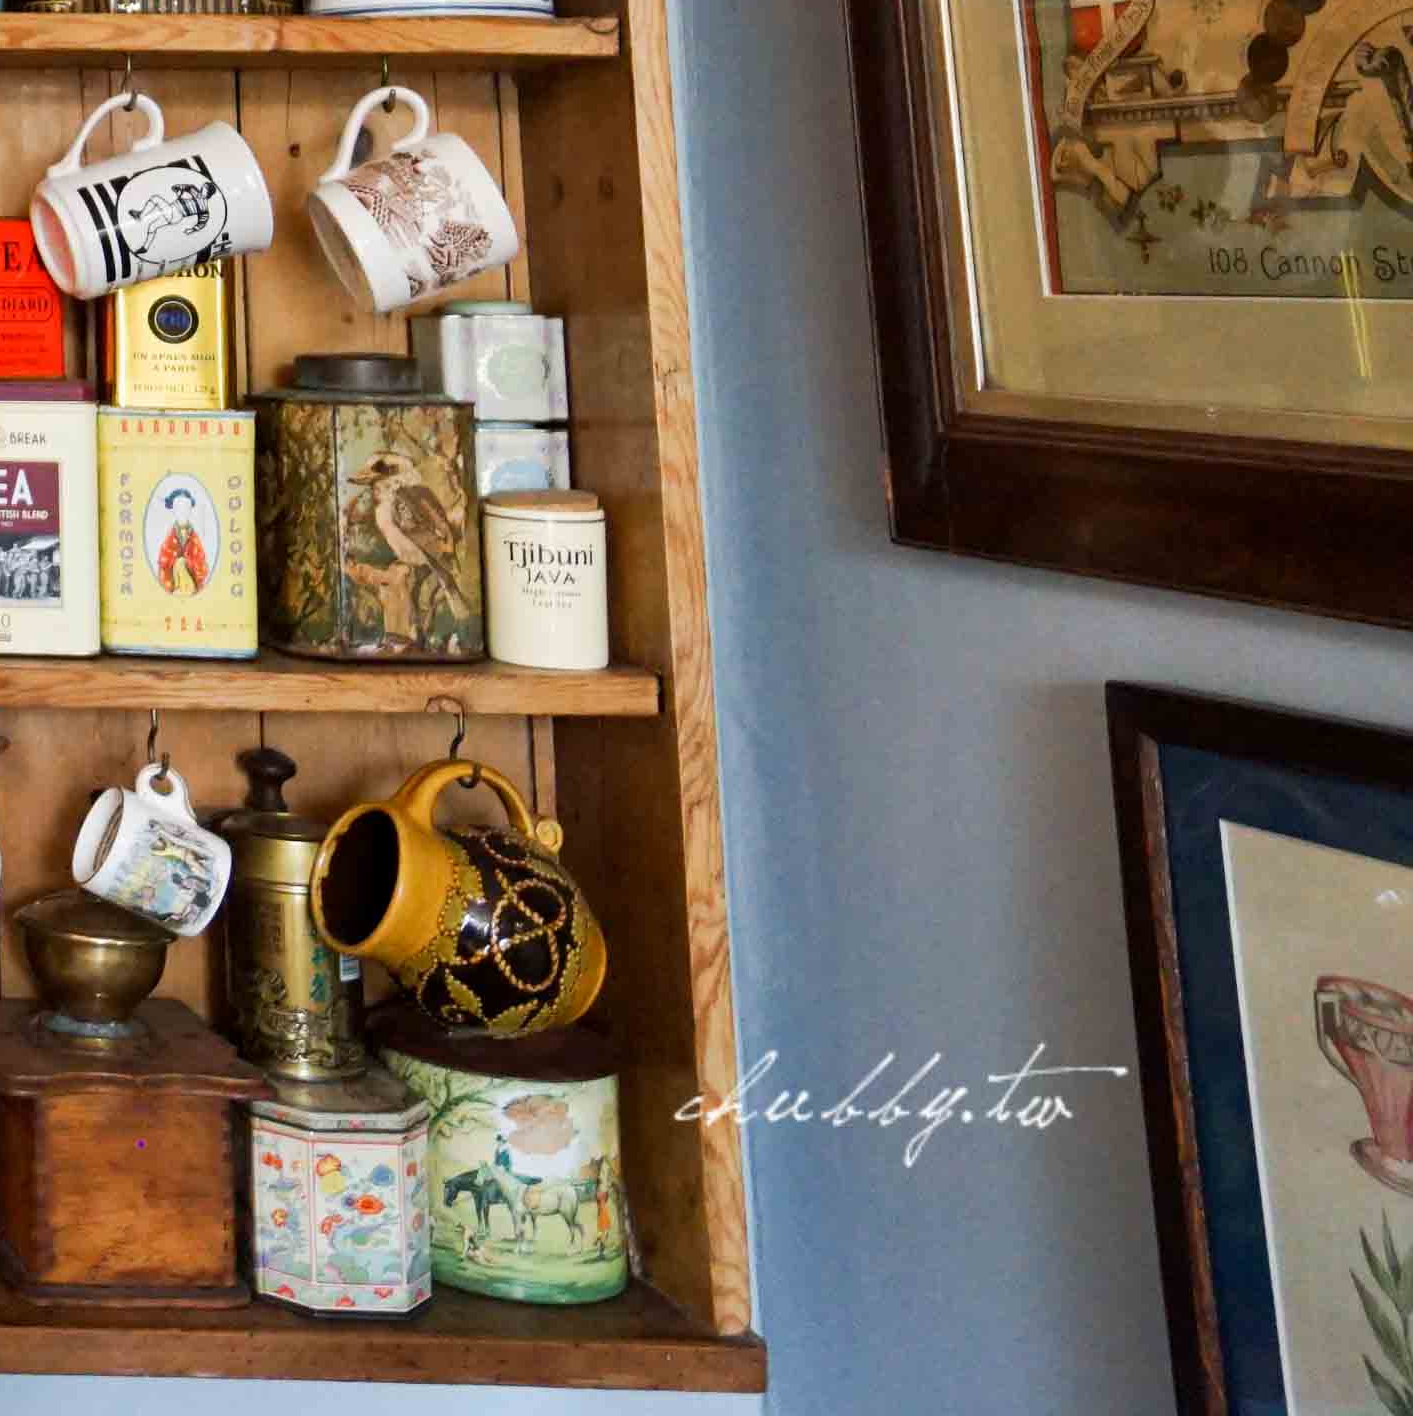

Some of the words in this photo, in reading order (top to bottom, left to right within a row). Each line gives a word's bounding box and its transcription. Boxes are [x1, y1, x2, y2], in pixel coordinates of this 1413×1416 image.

[1259, 246, 1361, 280] Cannon
[9, 431, 47, 445] BREAK
[21, 509, 50, 521] BLEND
[227, 472, 246, 598] OOLONG
[502, 539, 594, 569] Tjibuni
